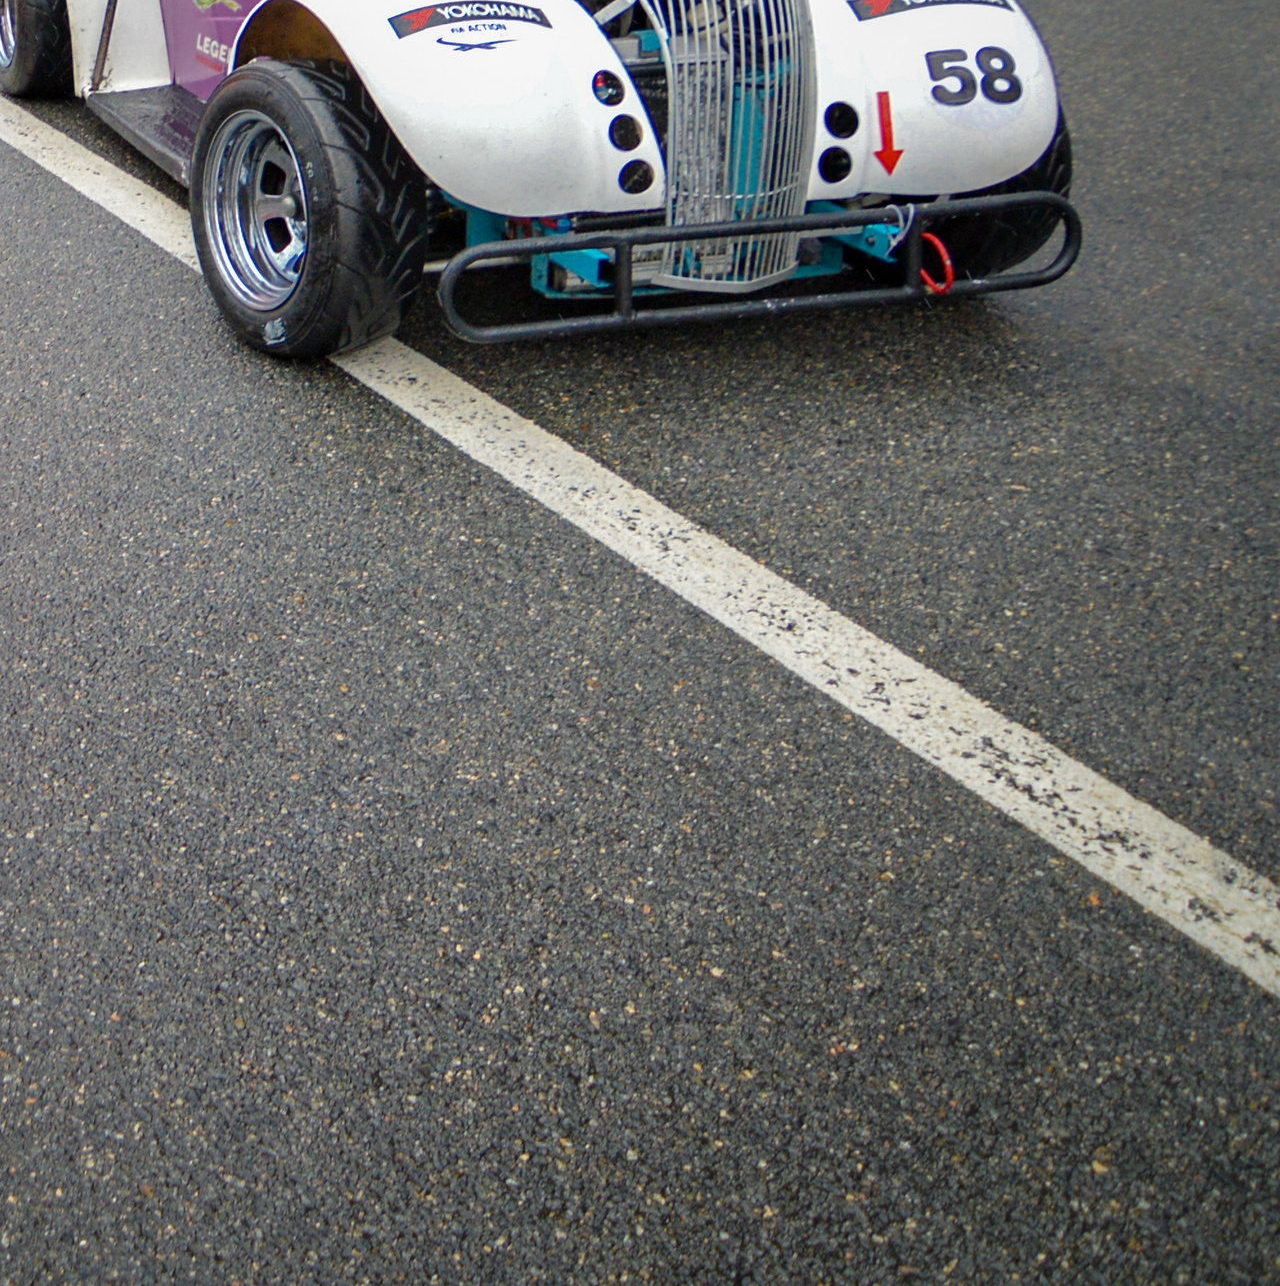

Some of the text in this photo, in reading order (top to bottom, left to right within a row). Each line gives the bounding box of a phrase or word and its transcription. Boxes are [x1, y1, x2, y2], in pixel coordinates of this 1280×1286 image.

[436, 2, 542, 22] YOKOHAMA
[468, 22, 508, 33] ACTION
[924, 45, 1024, 108] 58
